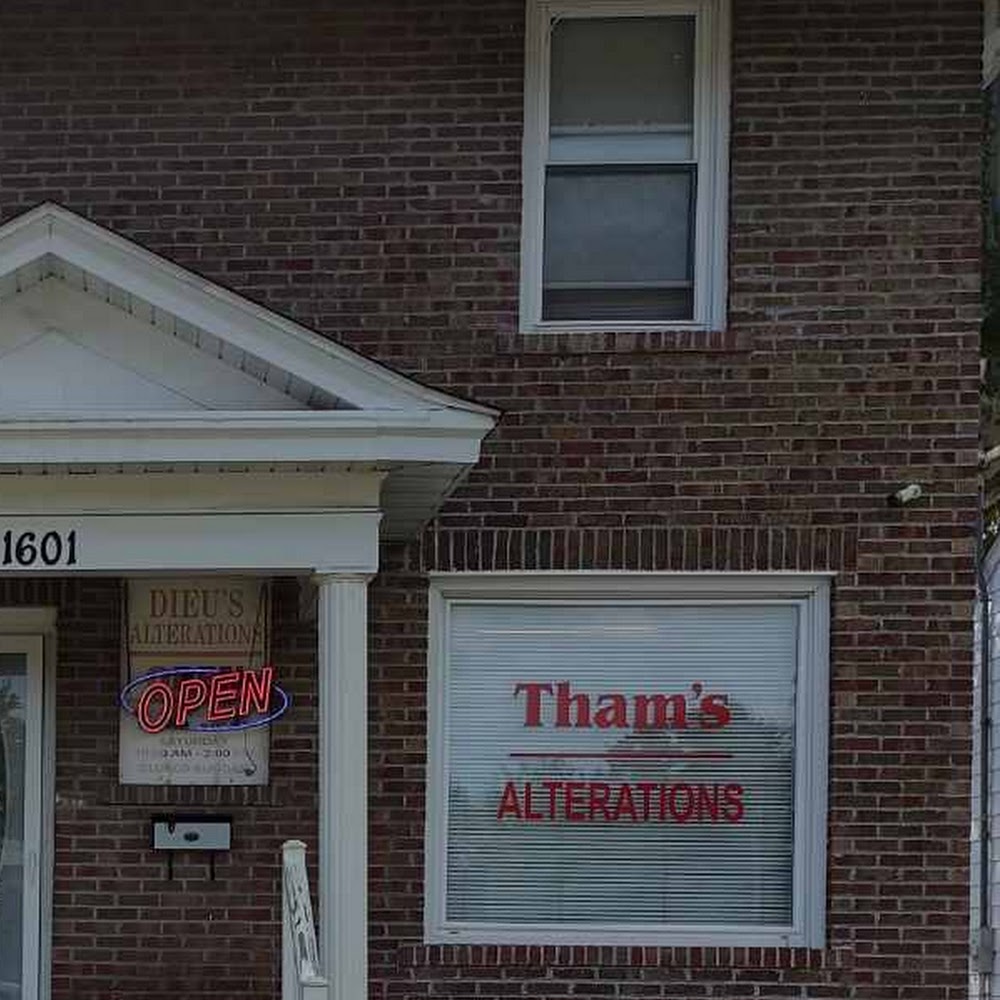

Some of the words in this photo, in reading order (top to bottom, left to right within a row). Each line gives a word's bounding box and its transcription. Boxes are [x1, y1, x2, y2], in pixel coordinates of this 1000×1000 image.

[2, 529, 77, 566] 1601
[149, 588, 245, 618] DIEU'S
[137, 666, 274, 734] OPEN
[513, 680, 732, 731] Tham's
[497, 780, 746, 824] ALTERATIONS
